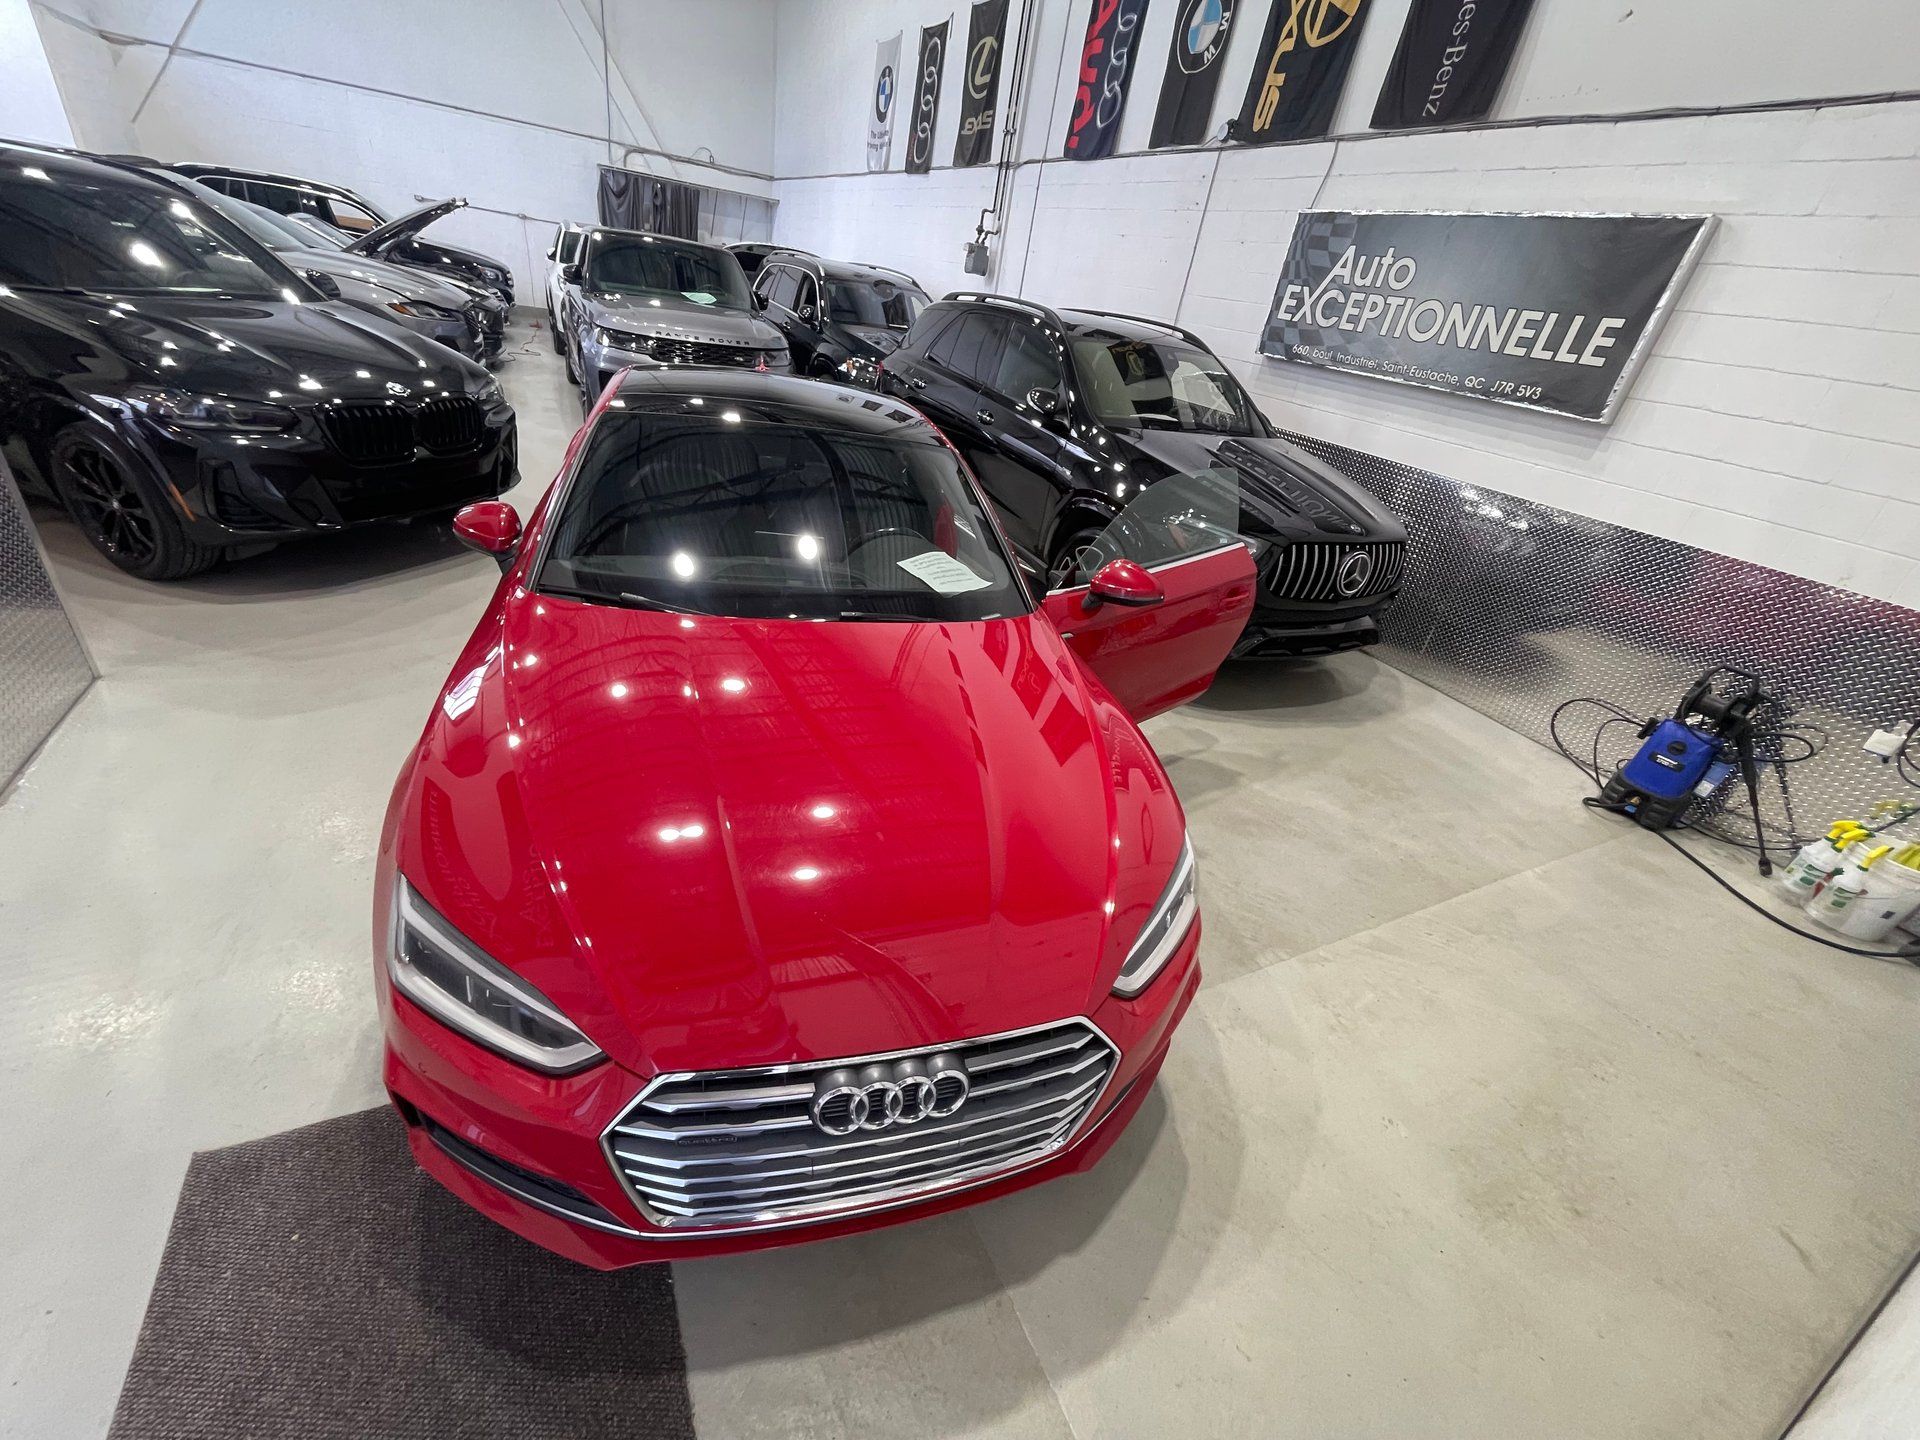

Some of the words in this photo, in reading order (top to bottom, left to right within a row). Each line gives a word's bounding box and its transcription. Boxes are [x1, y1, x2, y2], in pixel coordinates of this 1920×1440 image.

[1422, 0, 1477, 117] es-Benz
[1325, 245, 1416, 291] Auto
[709, 337, 750, 346] ROVER
[1277, 284, 1625, 367] EXCEPTIONNELLE
[1292, 343, 1310, 357] 660,
[1381, 360, 1460, 387] Saint-Eustache,
[1464, 375, 1486, 389] QC
[1490, 380, 1515, 395] J7R
[1516, 384, 1542, 400] 5V3
